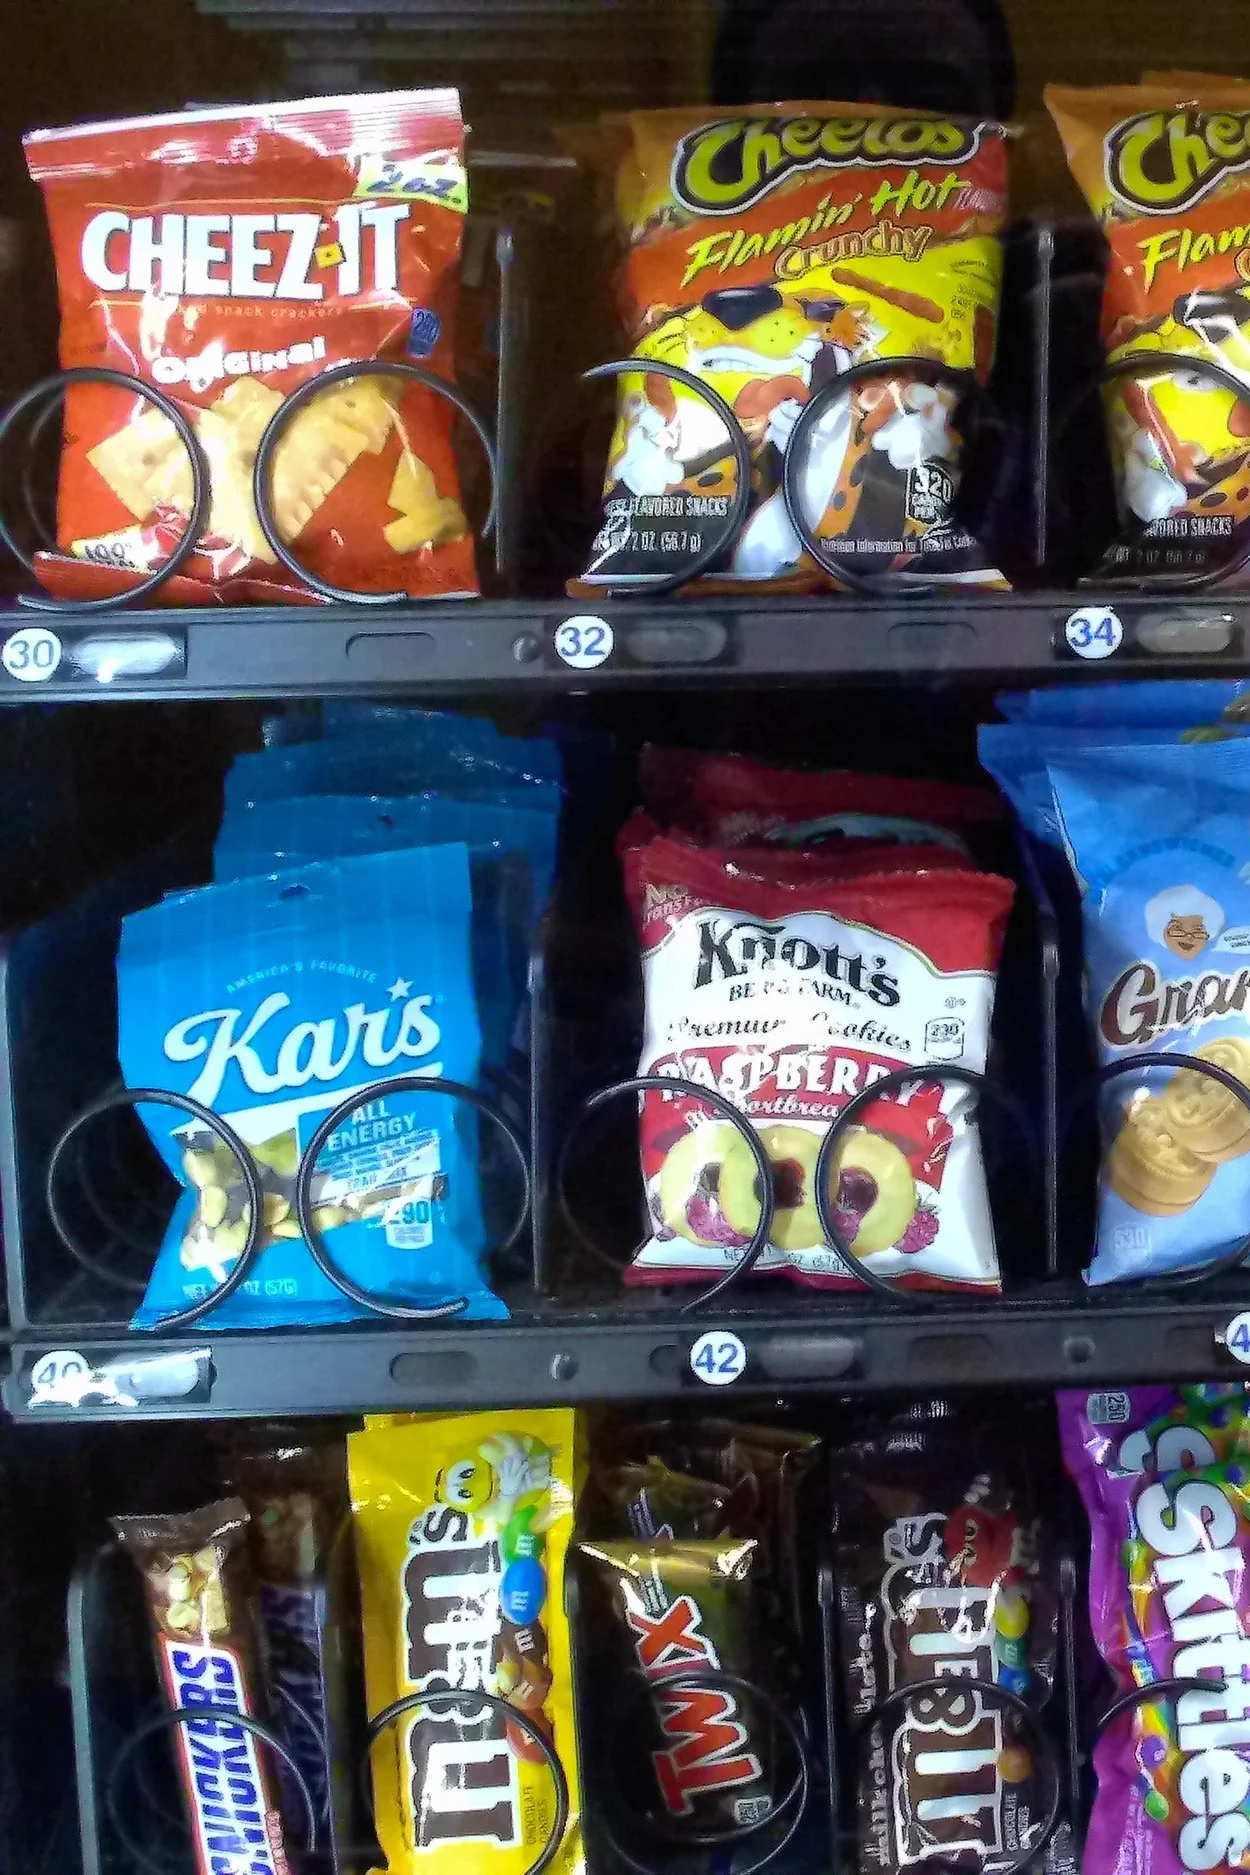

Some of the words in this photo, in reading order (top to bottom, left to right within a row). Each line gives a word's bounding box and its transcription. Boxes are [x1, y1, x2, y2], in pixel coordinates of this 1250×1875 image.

[680, 192, 863, 290] Flamin'
[869, 169, 972, 217] Hot
[774, 219, 934, 280] Crunchy
[1190, 516, 1233, 537] SNACKS
[559, 625, 606, 658] 32
[1069, 617, 1117, 648] 34
[9, 639, 55, 669] 30
[693, 917, 902, 1008] Knott's
[352, 1100, 392, 1125] ALL
[327, 1111, 418, 1151] ENERGY
[694, 1342, 740, 1374] 42
[629, 1594, 763, 1816] TWIX
